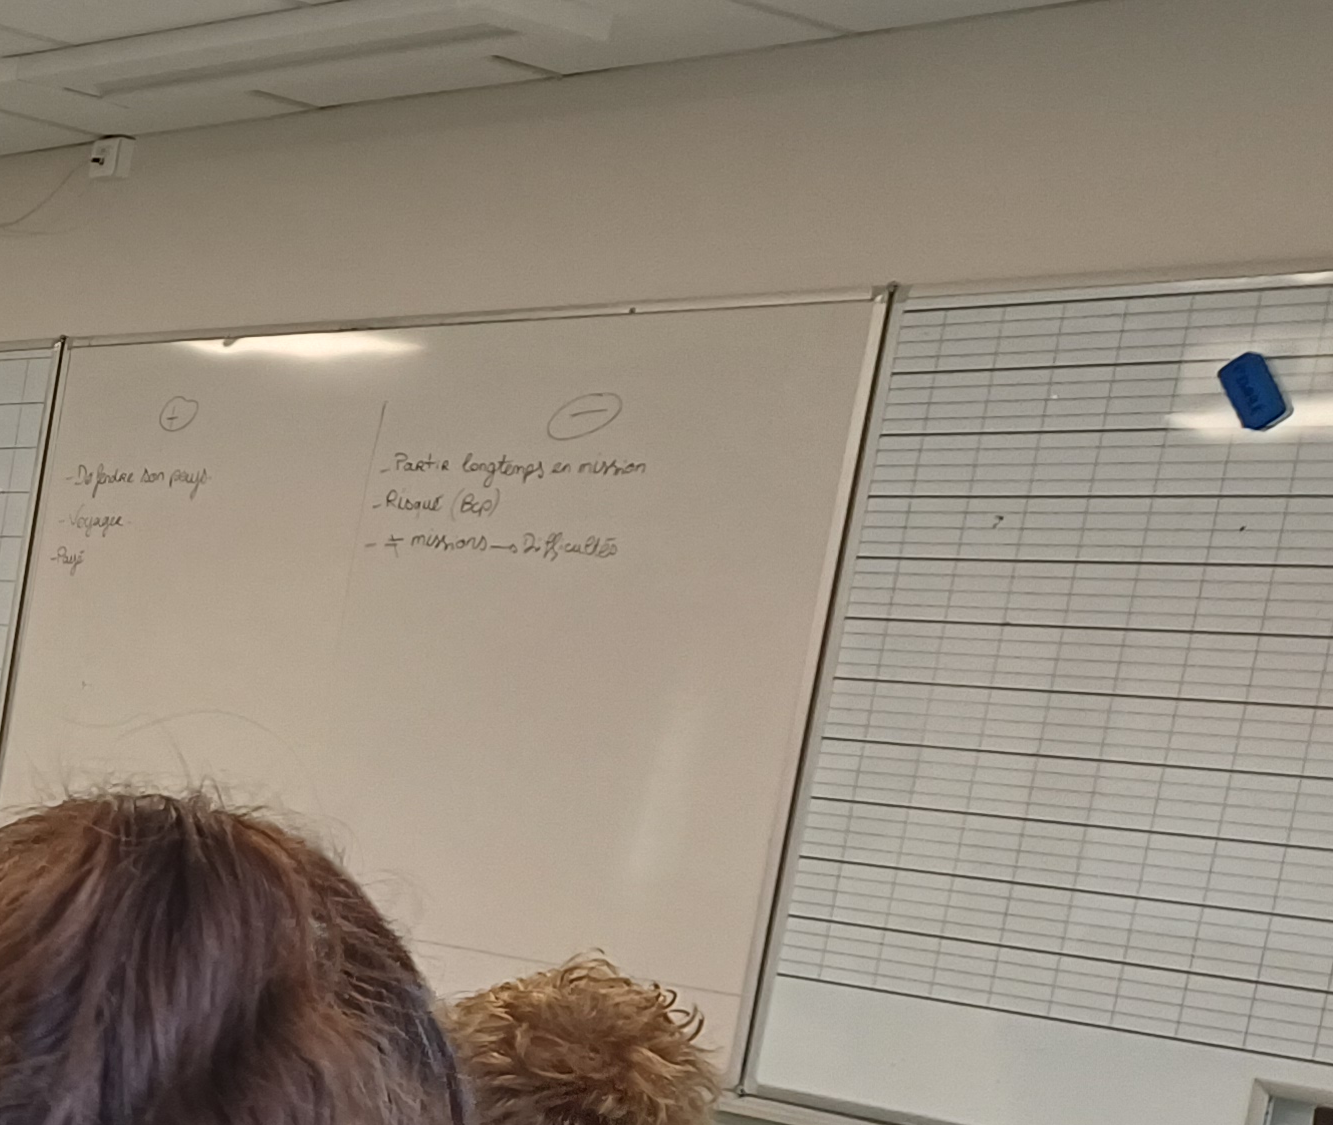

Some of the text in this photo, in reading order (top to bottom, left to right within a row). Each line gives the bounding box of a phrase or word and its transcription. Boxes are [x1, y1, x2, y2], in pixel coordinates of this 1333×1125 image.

[140, 467, 165, 483] son
[461, 452, 545, 489] longtemps
[549, 458, 571, 475] en
[576, 457, 647, 477] mission
